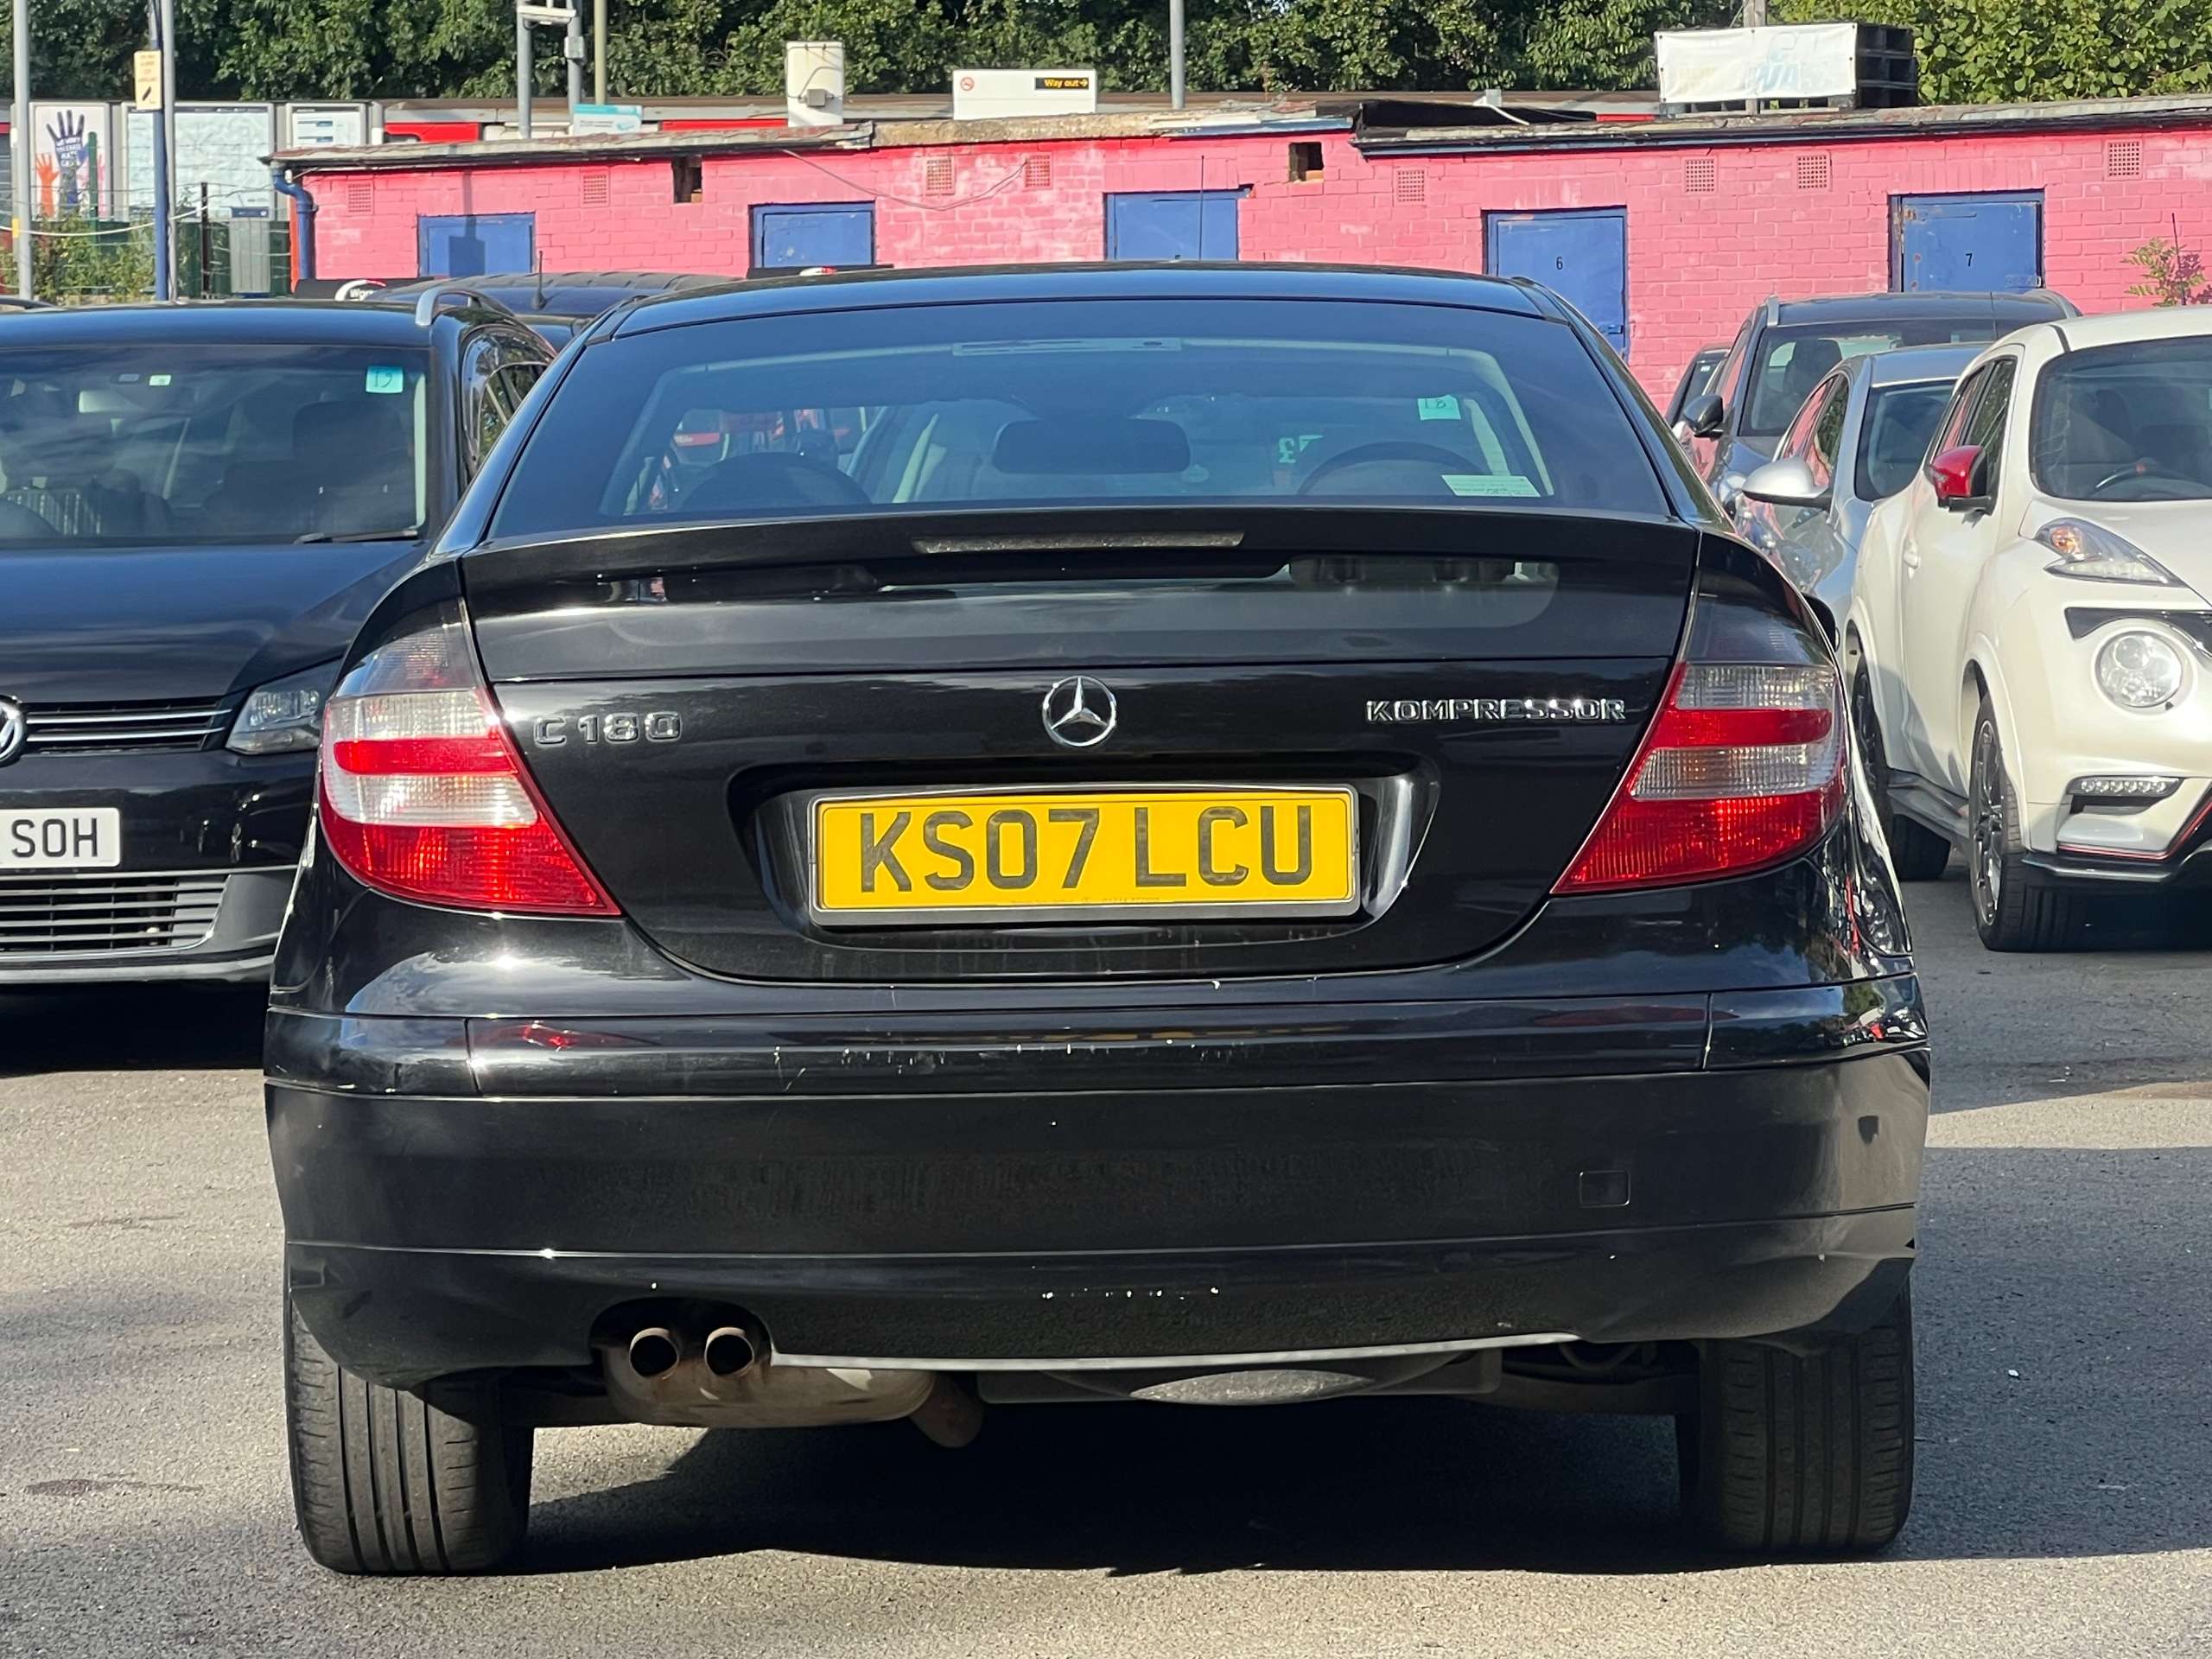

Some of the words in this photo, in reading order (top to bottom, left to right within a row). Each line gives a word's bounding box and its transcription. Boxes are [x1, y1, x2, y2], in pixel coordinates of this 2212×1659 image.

[1044, 79, 1063, 88] Way
[1556, 256, 1563, 270] 6
[1965, 252, 1973, 267] 7
[1365, 698, 1626, 721] KOMPRESSOR
[533, 716, 568, 748] C
[577, 712, 683, 744] 180
[11, 817, 98, 858] SOH
[860, 808, 1100, 893] KS07
[1134, 804, 1313, 887] LCU
